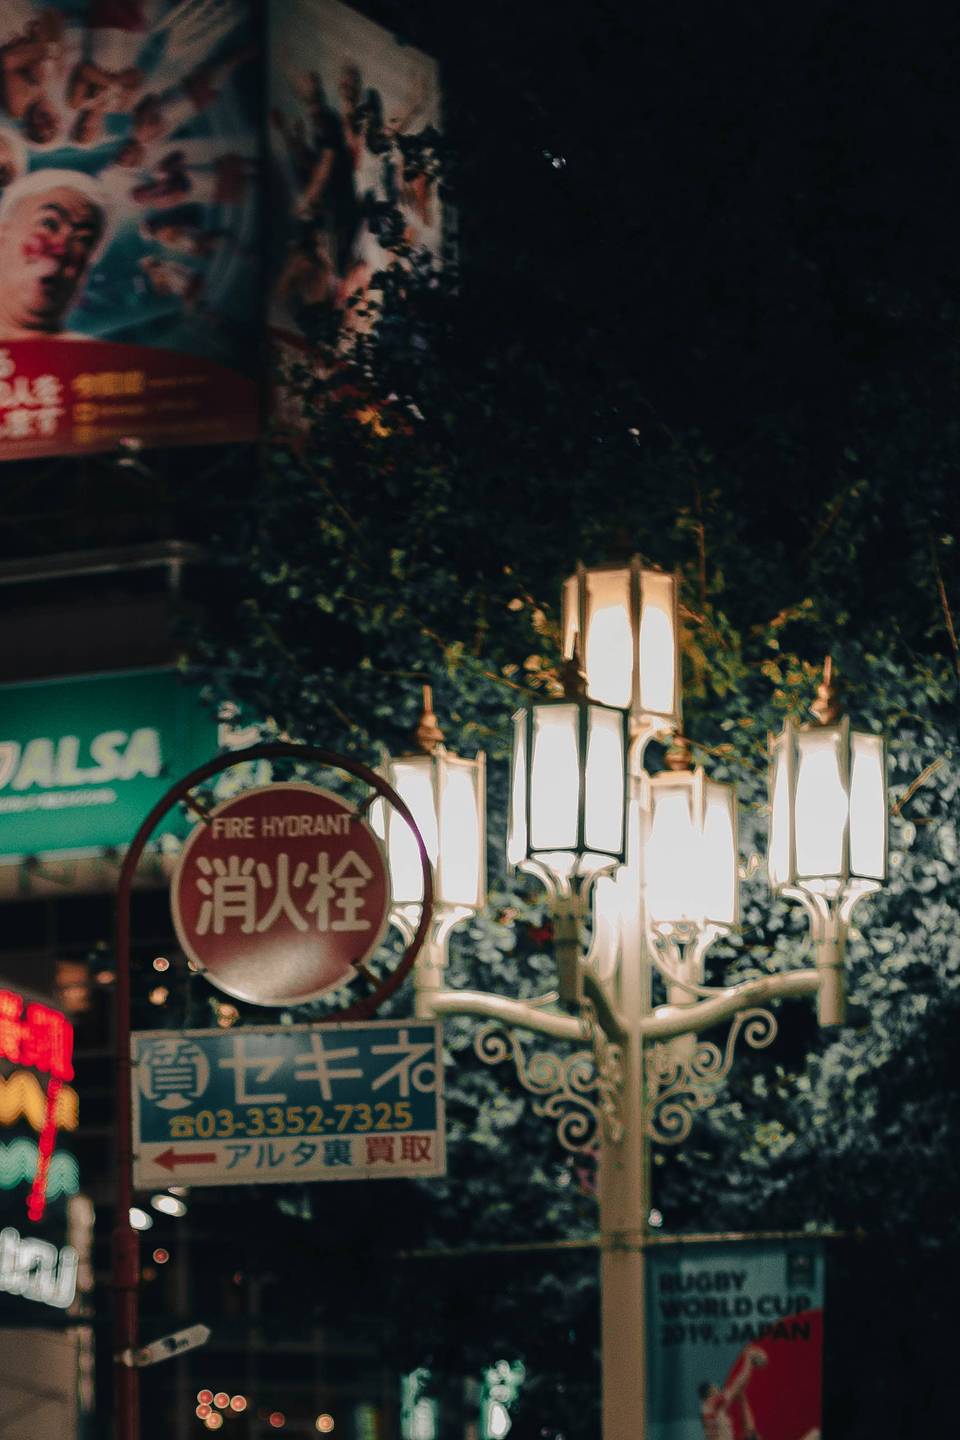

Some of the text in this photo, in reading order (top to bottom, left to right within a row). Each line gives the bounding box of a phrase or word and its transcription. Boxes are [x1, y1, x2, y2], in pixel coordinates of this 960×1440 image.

[211, 814, 352, 840] FIRE HYDRANT
[195, 850, 373, 936] 消火栓
[219, 1029, 438, 1104] セキネ
[196, 1102, 414, 1137] 03-3352-7325
[224, 1135, 431, 1170] アルタ裏 買取
[659, 1271, 746, 1292] RUGBY
[659, 1294, 811, 1318] WORLD CUP
[726, 1322, 812, 1344] JAPAN
